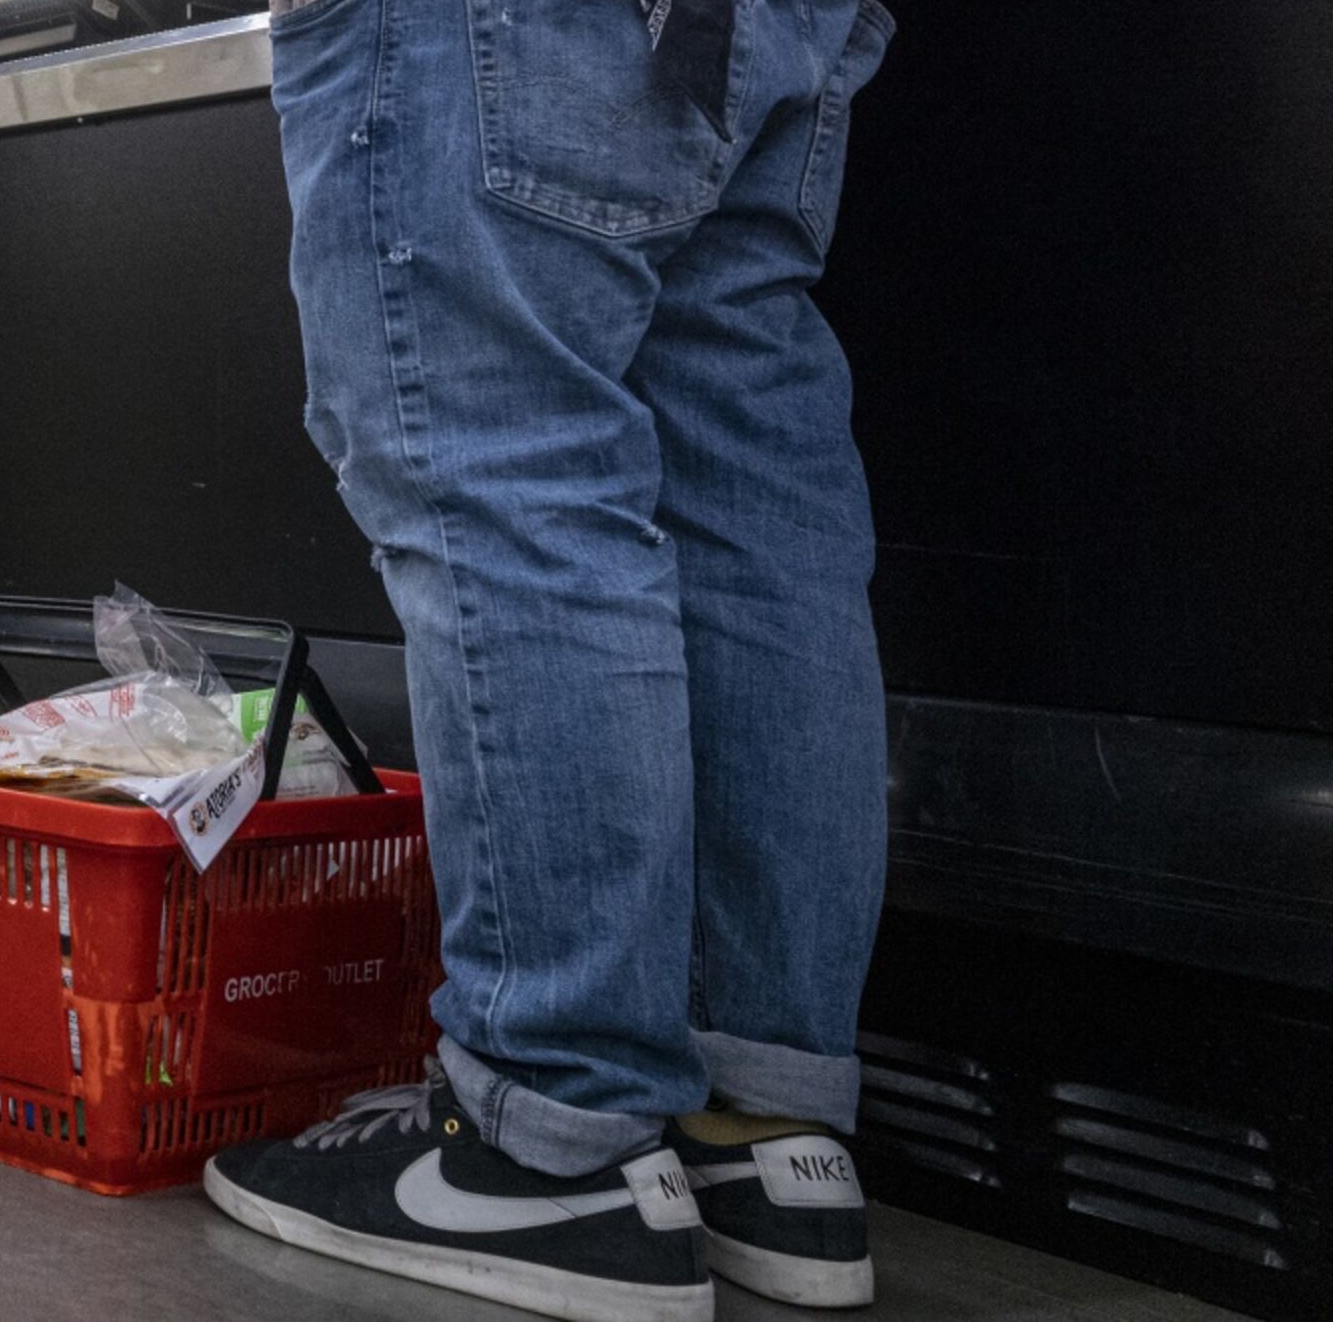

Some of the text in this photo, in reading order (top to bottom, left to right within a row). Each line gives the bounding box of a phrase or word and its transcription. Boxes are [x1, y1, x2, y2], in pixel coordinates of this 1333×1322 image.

[205, 772, 242, 820] ATORIA'S
[224, 969, 301, 1003] GROCER
[789, 1155, 851, 1181] NIKE
